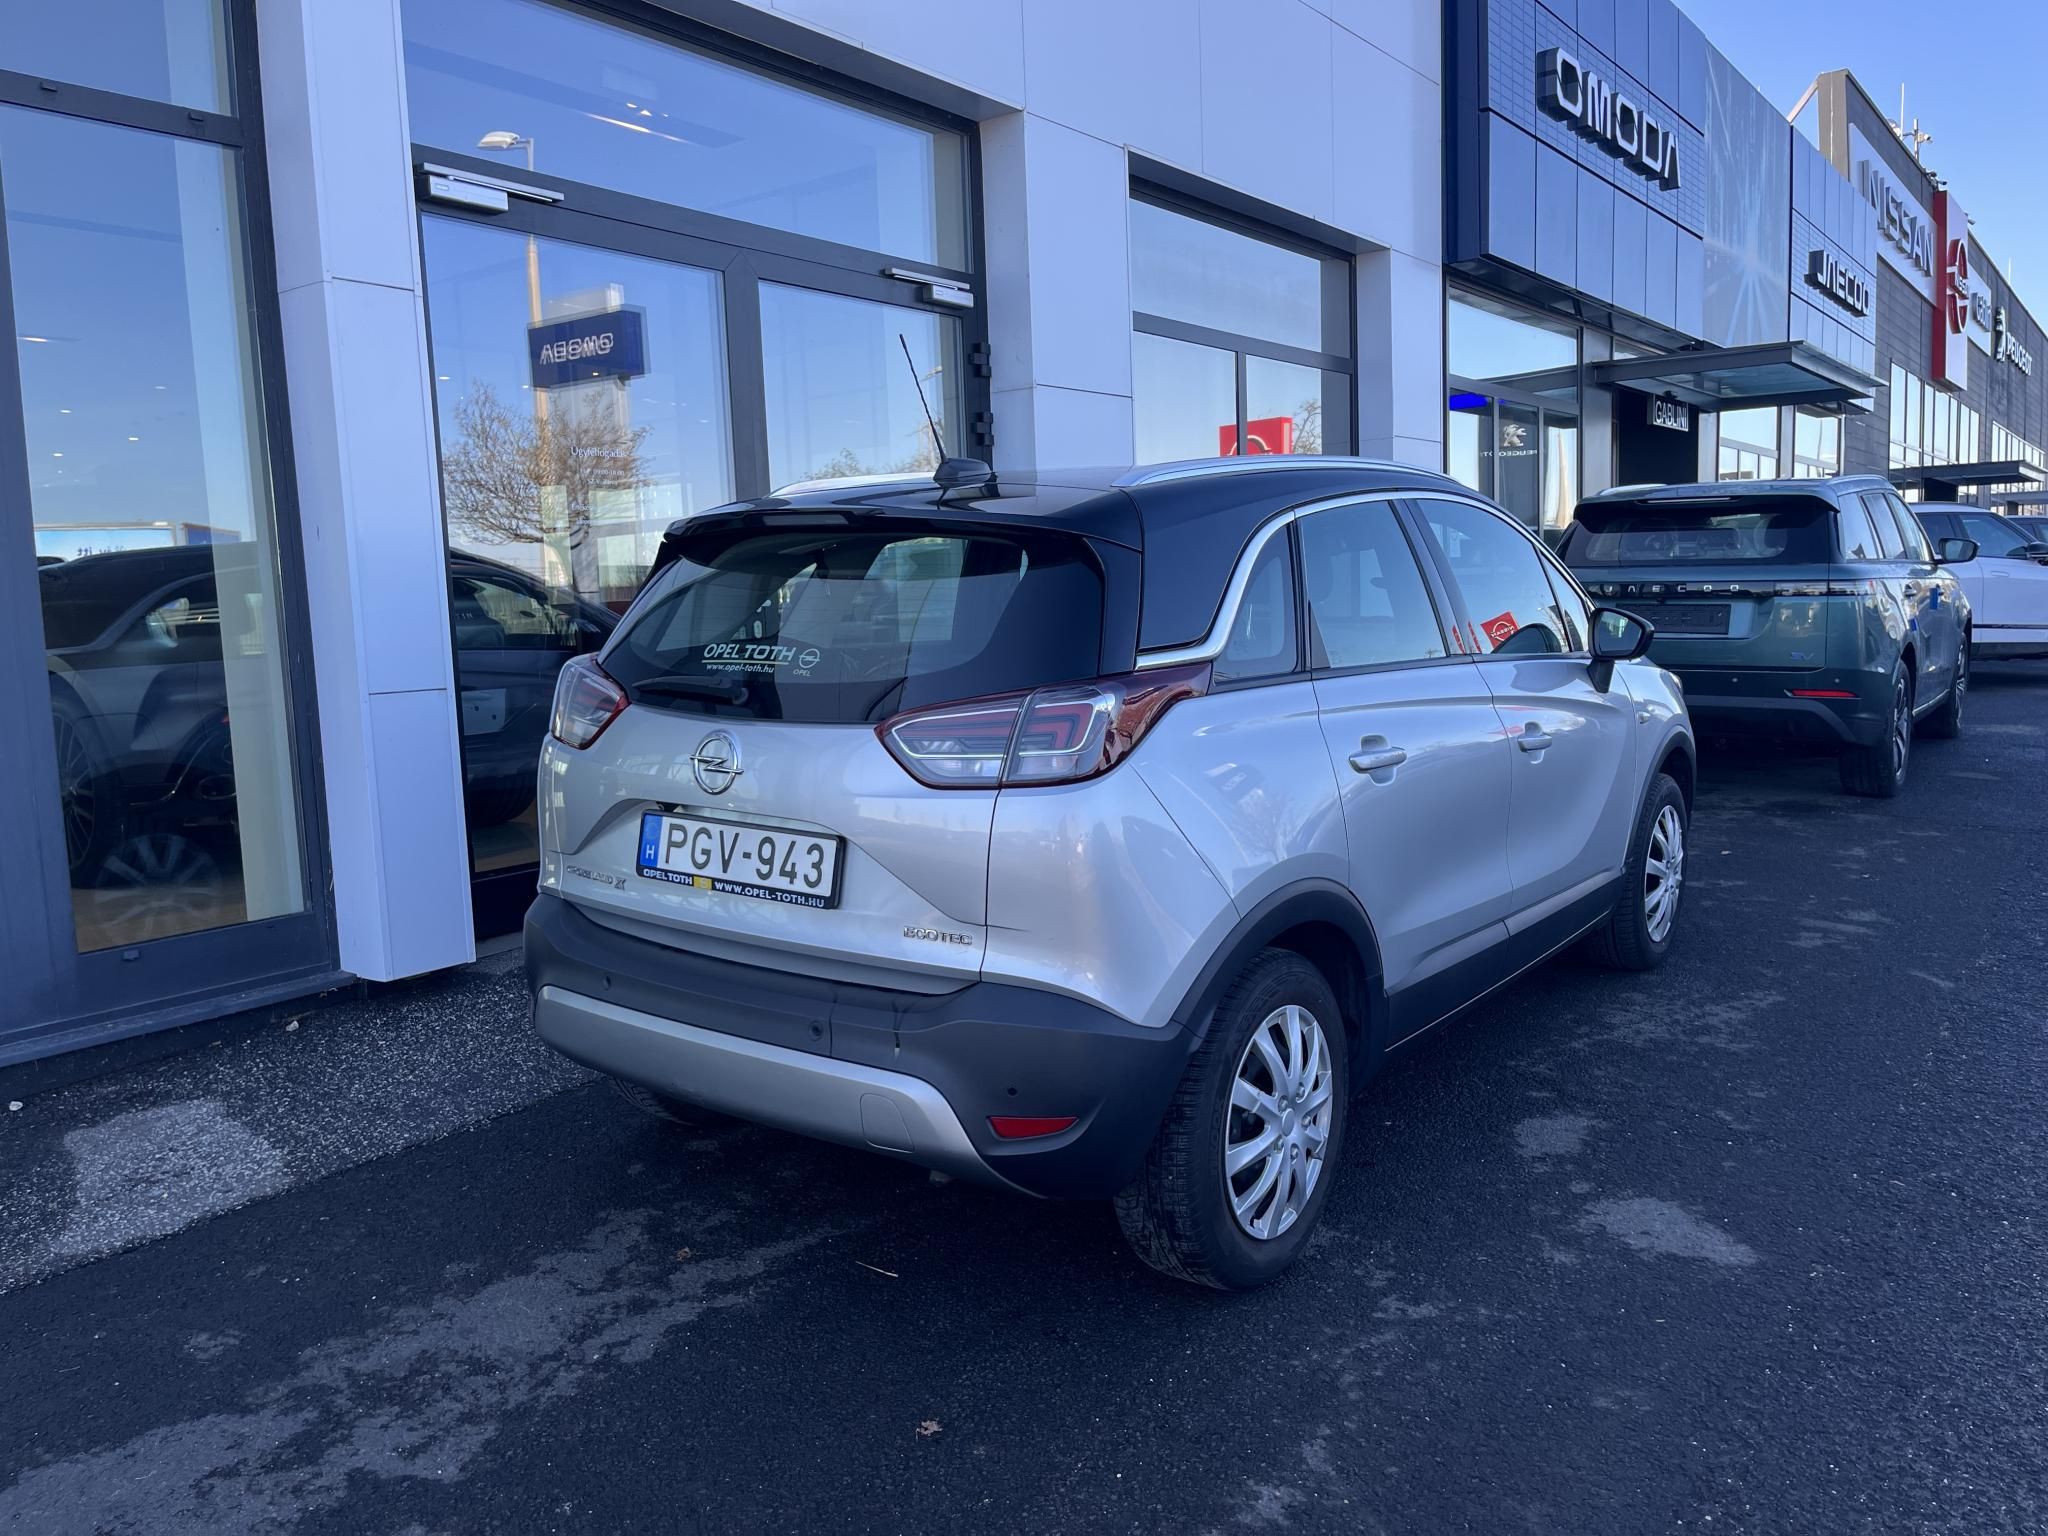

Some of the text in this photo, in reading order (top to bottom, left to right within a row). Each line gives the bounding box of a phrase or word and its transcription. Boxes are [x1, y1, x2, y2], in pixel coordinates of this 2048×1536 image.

[1555, 47, 1681, 189] OMODA
[1860, 160, 1934, 277] NISSAN
[1816, 250, 1870, 316] JAECOO
[2006, 332, 2033, 376] PEUGEOT
[1655, 400, 1687, 430] GABLINI
[1606, 583, 1740, 593] JAECOO
[703, 643, 797, 661] OPEL TOTH
[706, 664, 775, 674] www.opel-toth.hu
[792, 669, 812, 677] OPEL
[645, 844, 655, 860] H
[665, 823, 825, 889] PGV-943
[643, 869, 667, 881] OPEL
[667, 873, 692, 885] TOTH
[714, 880, 825, 908] WWW.OPEL-TOTH.HU
